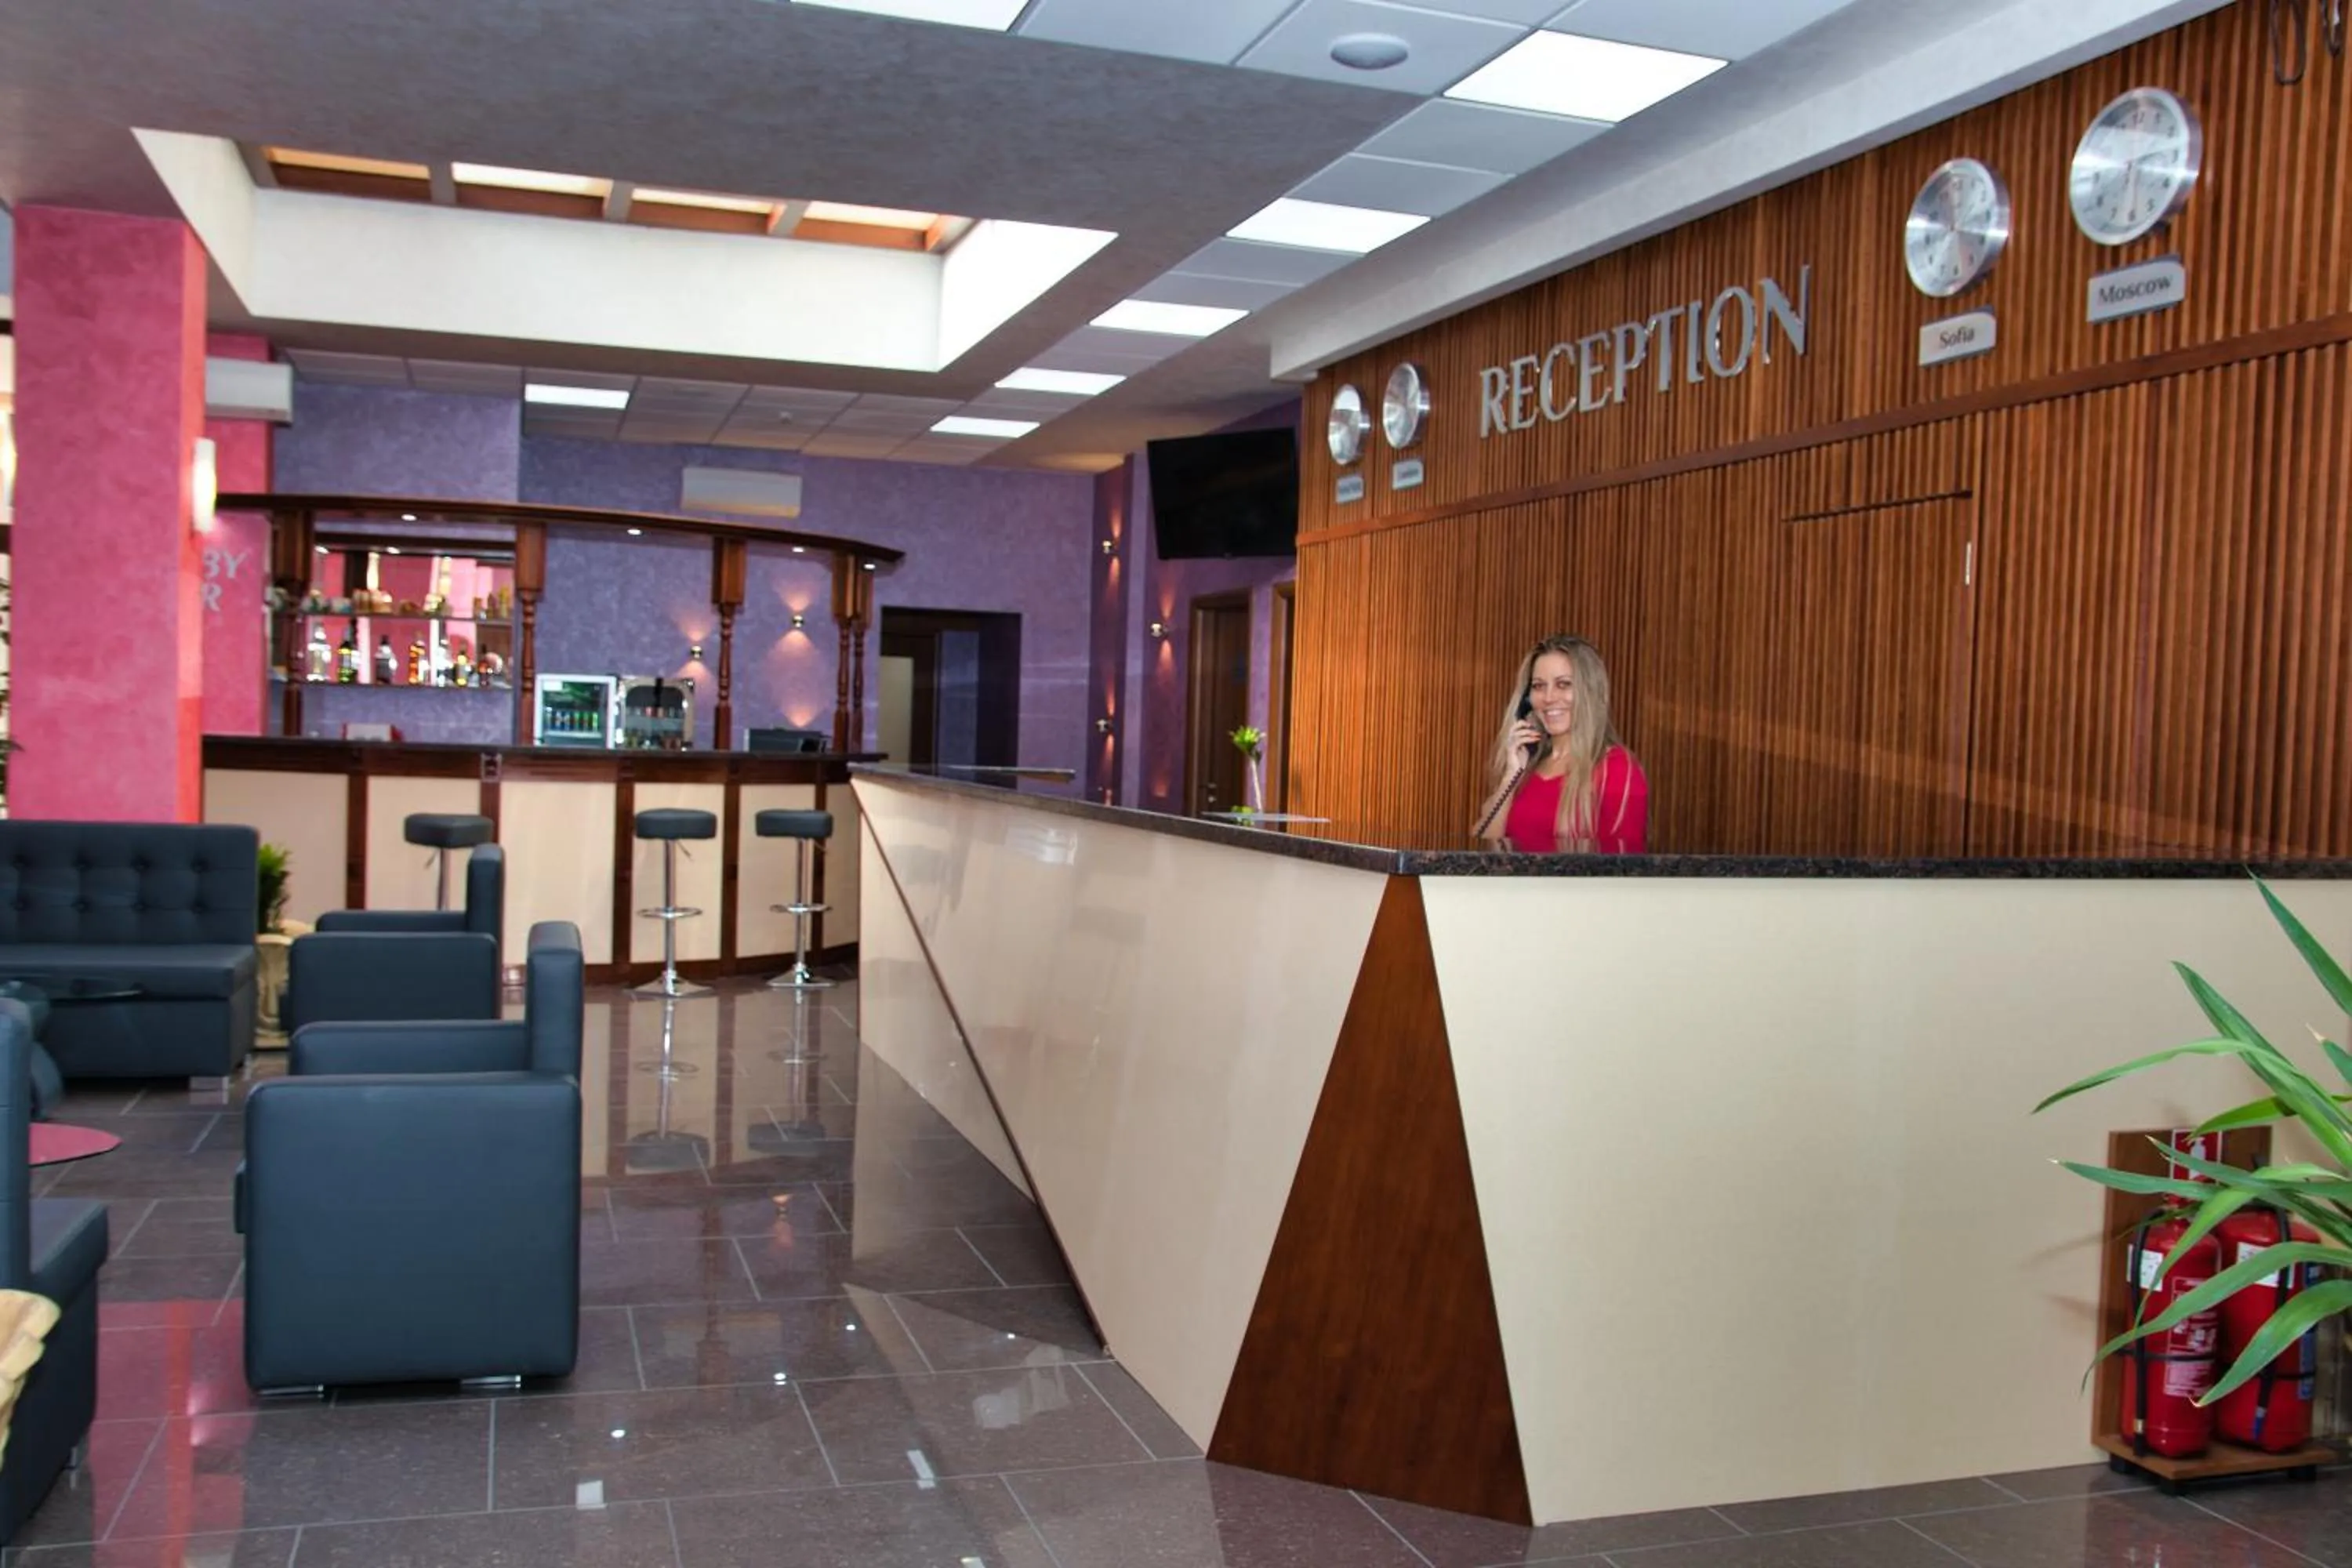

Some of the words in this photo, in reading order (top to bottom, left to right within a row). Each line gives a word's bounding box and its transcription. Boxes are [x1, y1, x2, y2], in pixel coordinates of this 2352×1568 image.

[2097, 274, 2174, 305] Moscow
[1479, 264, 1810, 439] RECEPTION
[1939, 326, 1975, 350] Sofia
